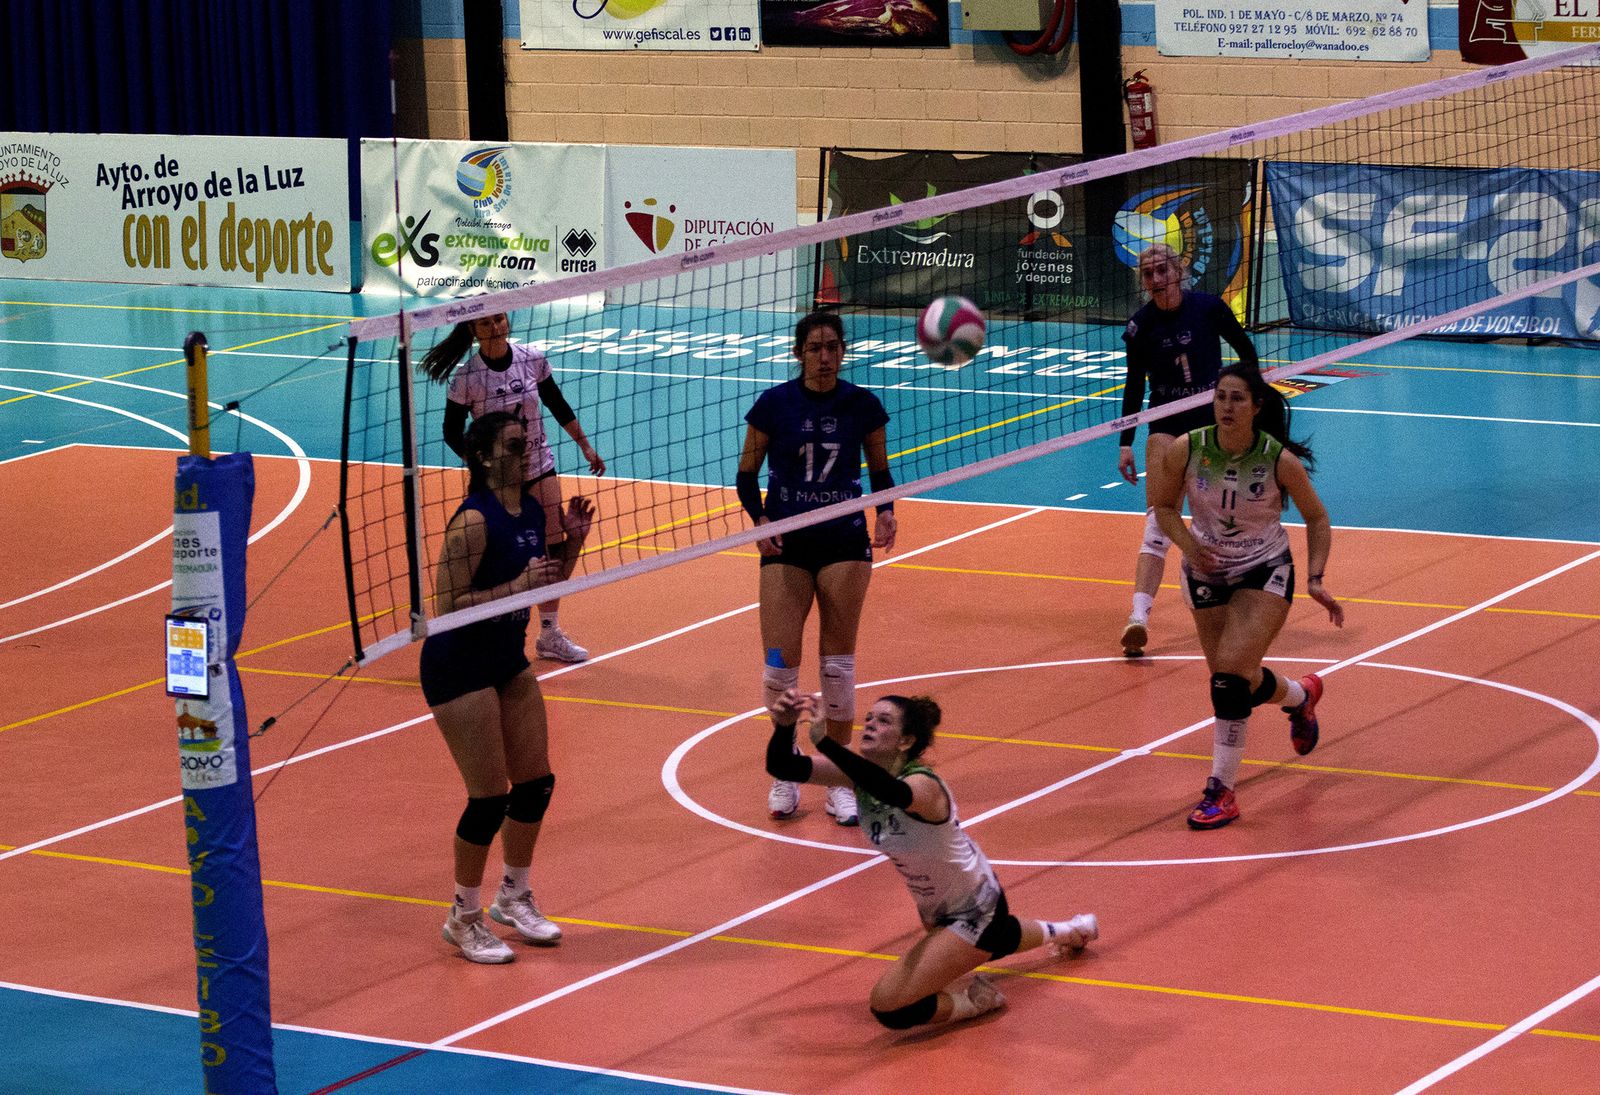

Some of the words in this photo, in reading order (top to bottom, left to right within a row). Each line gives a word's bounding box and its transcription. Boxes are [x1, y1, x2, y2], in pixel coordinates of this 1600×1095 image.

[1183, 9, 1204, 19] POL.
[1207, 9, 1227, 19] IND.
[1230, 10, 1234, 19] 1
[1238, 10, 1252, 20] DE
[1254, 10, 1286, 20] MAYO
[1315, 11, 1329, 21] DE
[1332, 12, 1373, 23] MARZO,
[1391, 13, 1404, 23] 74
[603, 28, 701, 43] www.gefiscal.es
[1174, 21, 1227, 33] TELÉFONO
[1229, 24, 1248, 34] 927
[1251, 24, 1265, 34] 27
[1269, 25, 1281, 34] 12
[1283, 25, 1297, 35] 95
[1305, 23, 1340, 36] MÓVIL:
[1346, 26, 1366, 36] 692
[1372, 27, 1386, 37] 62
[1389, 27, 1402, 37] 88
[1405, 28, 1418, 37] 70
[1571, 26, 1600, 38] FER
[1218, 38, 1253, 49] E-mail:
[1255, 38, 1369, 52] palleroeloy@wanadoo.es
[21, 157, 35, 168] DE
[37, 160, 49, 174] LA
[50, 168, 70, 189] LUZ
[96, 162, 150, 192] Ayto.
[154, 153, 179, 179] de
[121, 181, 198, 211] Arroyo
[204, 171, 233, 199] de
[237, 167, 259, 195] la
[263, 165, 305, 191] Luz
[685, 218, 774, 236] DIPUTACIÓN
[123, 213, 170, 269] con
[181, 201, 208, 270] el
[219, 201, 335, 283] deporte
[445, 232, 550, 253] extremadura
[459, 253, 536, 272] sport.com
[857, 245, 975, 269] Extremadura
[1017, 248, 1073, 260] fundación
[561, 258, 597, 273] errea
[1015, 260, 1073, 273] jóvenes
[417, 276, 484, 289] patrocinador
[1016, 274, 1023, 283] y
[1025, 272, 1072, 284] deporte
[1459, 316, 1486, 333] DE
[1485, 316, 1562, 336] VOLEIBOL
[1175, 353, 1192, 382] 1
[799, 443, 841, 483] 17
[796, 490, 853, 503] MADRID
[1222, 489, 1237, 510] 11
[871, 821, 881, 845] 8
